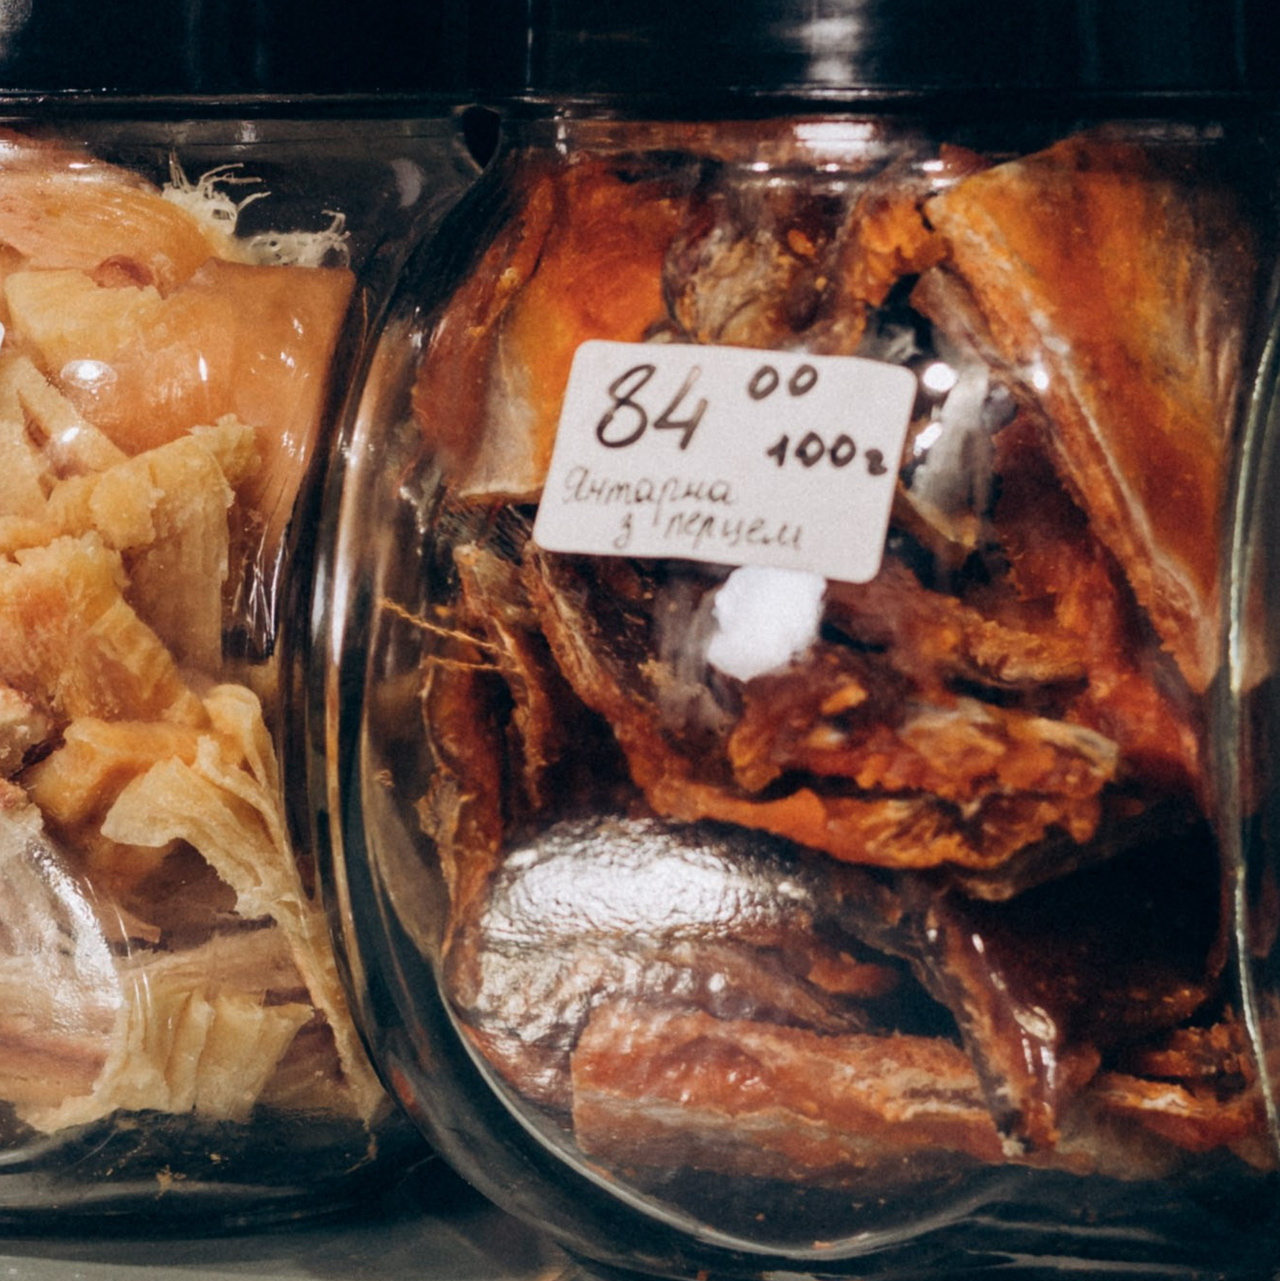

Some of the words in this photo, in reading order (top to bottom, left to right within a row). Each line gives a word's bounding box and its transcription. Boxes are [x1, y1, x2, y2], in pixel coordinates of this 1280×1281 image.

[596, 364, 708, 450] 84
[747, 364, 818, 400] 00
[664, 508, 803, 551] перцем
